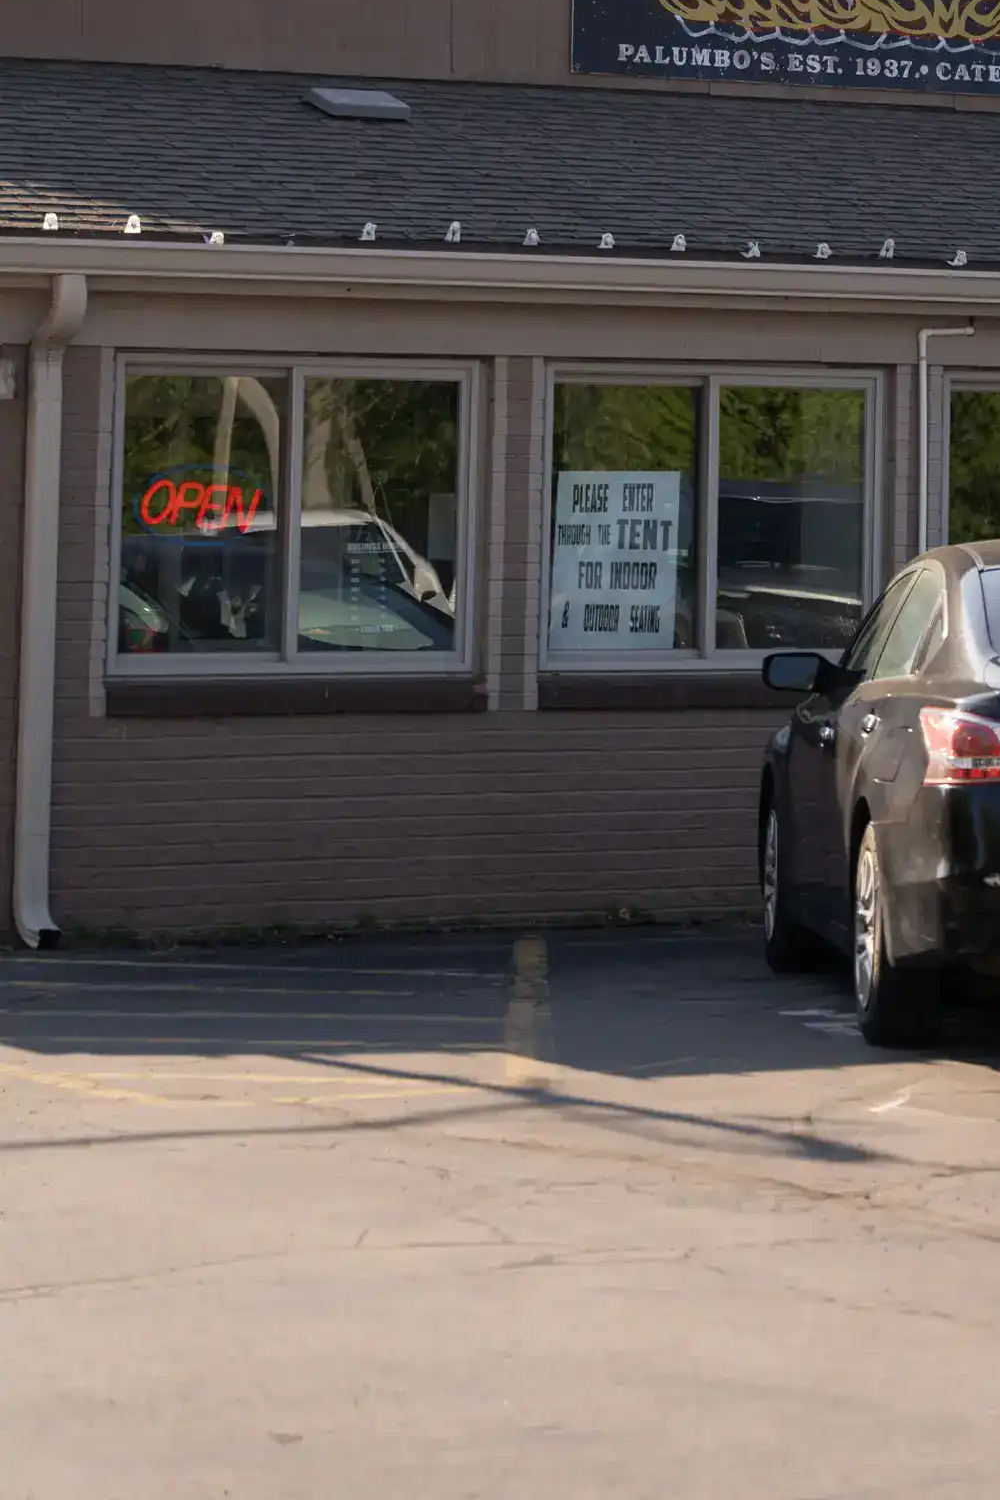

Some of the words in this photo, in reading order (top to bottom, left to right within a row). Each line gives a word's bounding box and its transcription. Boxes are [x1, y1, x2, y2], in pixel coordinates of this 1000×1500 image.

[617, 44, 775, 71] PALUMBO'S
[787, 54, 843, 74] EST.
[140, 479, 262, 534] OPEN
[572, 483, 609, 513] PLEASE
[622, 483, 654, 512] ENTER
[557, 524, 591, 546] THROUGH
[598, 524, 611, 545] THE
[616, 518, 673, 551] TENT
[578, 561, 602, 589] FOR
[610, 561, 657, 590] INDOOR
[561, 601, 570, 628] &
[583, 604, 620, 632] OUTDOOR
[630, 605, 660, 633] SEATING
